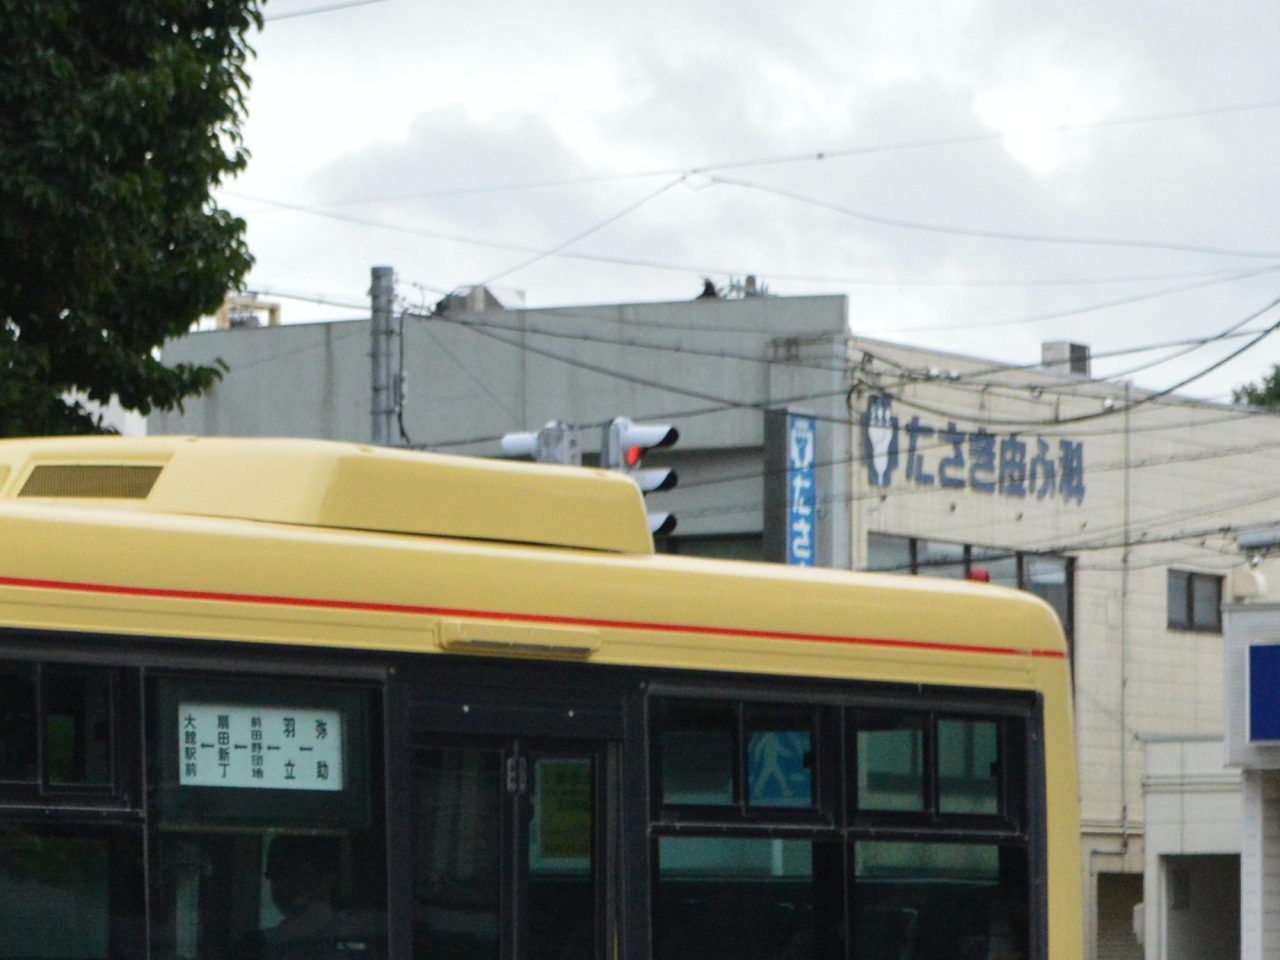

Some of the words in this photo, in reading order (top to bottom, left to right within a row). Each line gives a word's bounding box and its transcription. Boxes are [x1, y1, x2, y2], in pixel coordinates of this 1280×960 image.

[791, 474, 812, 567] たさ
[184, 713, 197, 778] 大館駅前
[217, 715, 230, 778] 扇田新丁
[250, 716, 264, 779] 前田野団地
[283, 717, 296, 780] 羽立
